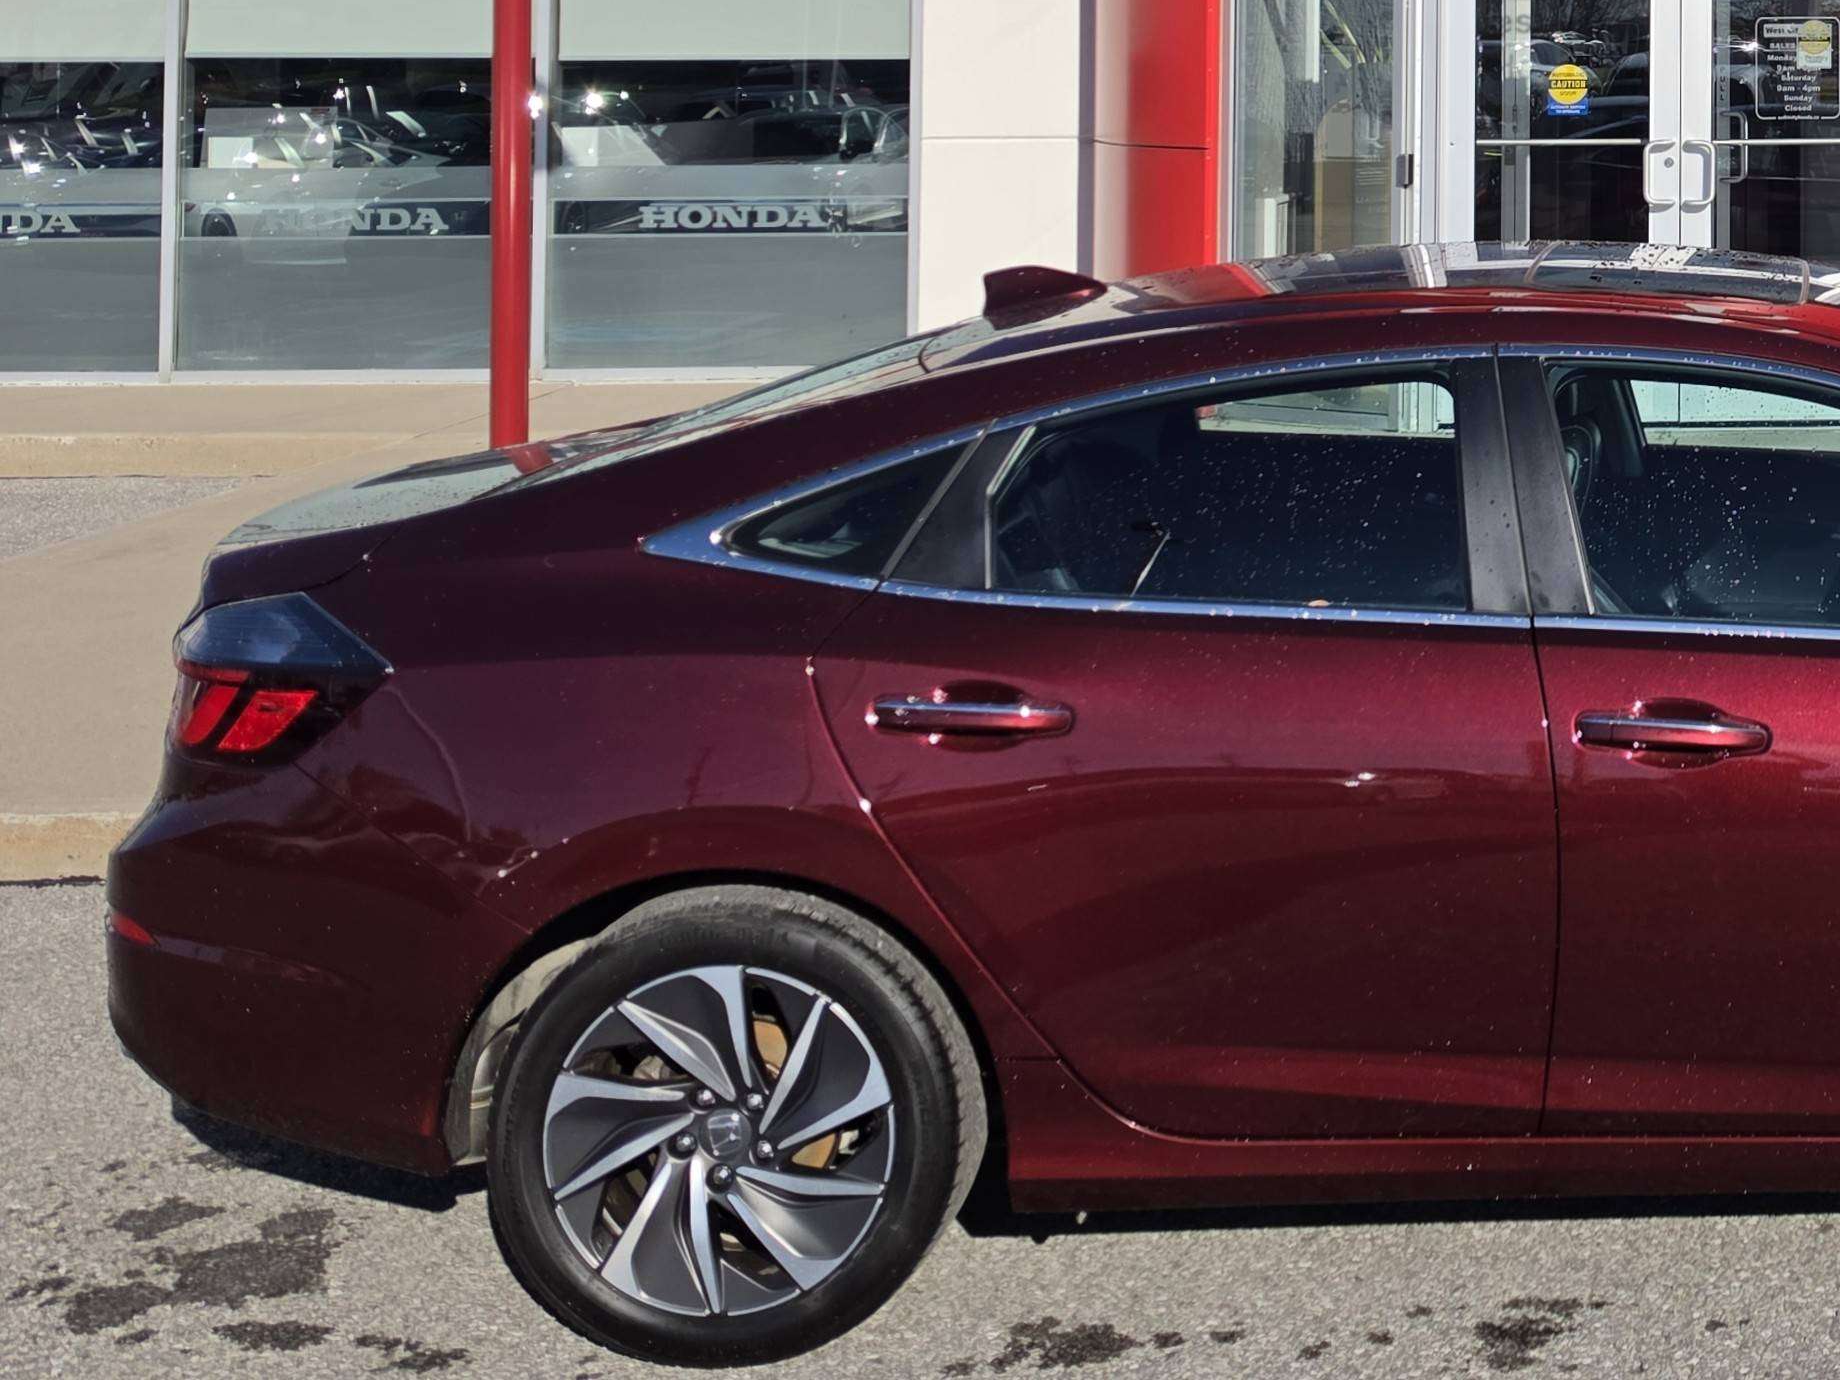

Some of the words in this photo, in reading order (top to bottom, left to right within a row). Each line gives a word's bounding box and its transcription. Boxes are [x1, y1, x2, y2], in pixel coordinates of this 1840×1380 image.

[1551, 80, 1586, 88] CAUTION
[1784, 94, 1813, 102] Sunday
[1784, 104, 1813, 112] Closed
[638, 205, 830, 228] HONDA
